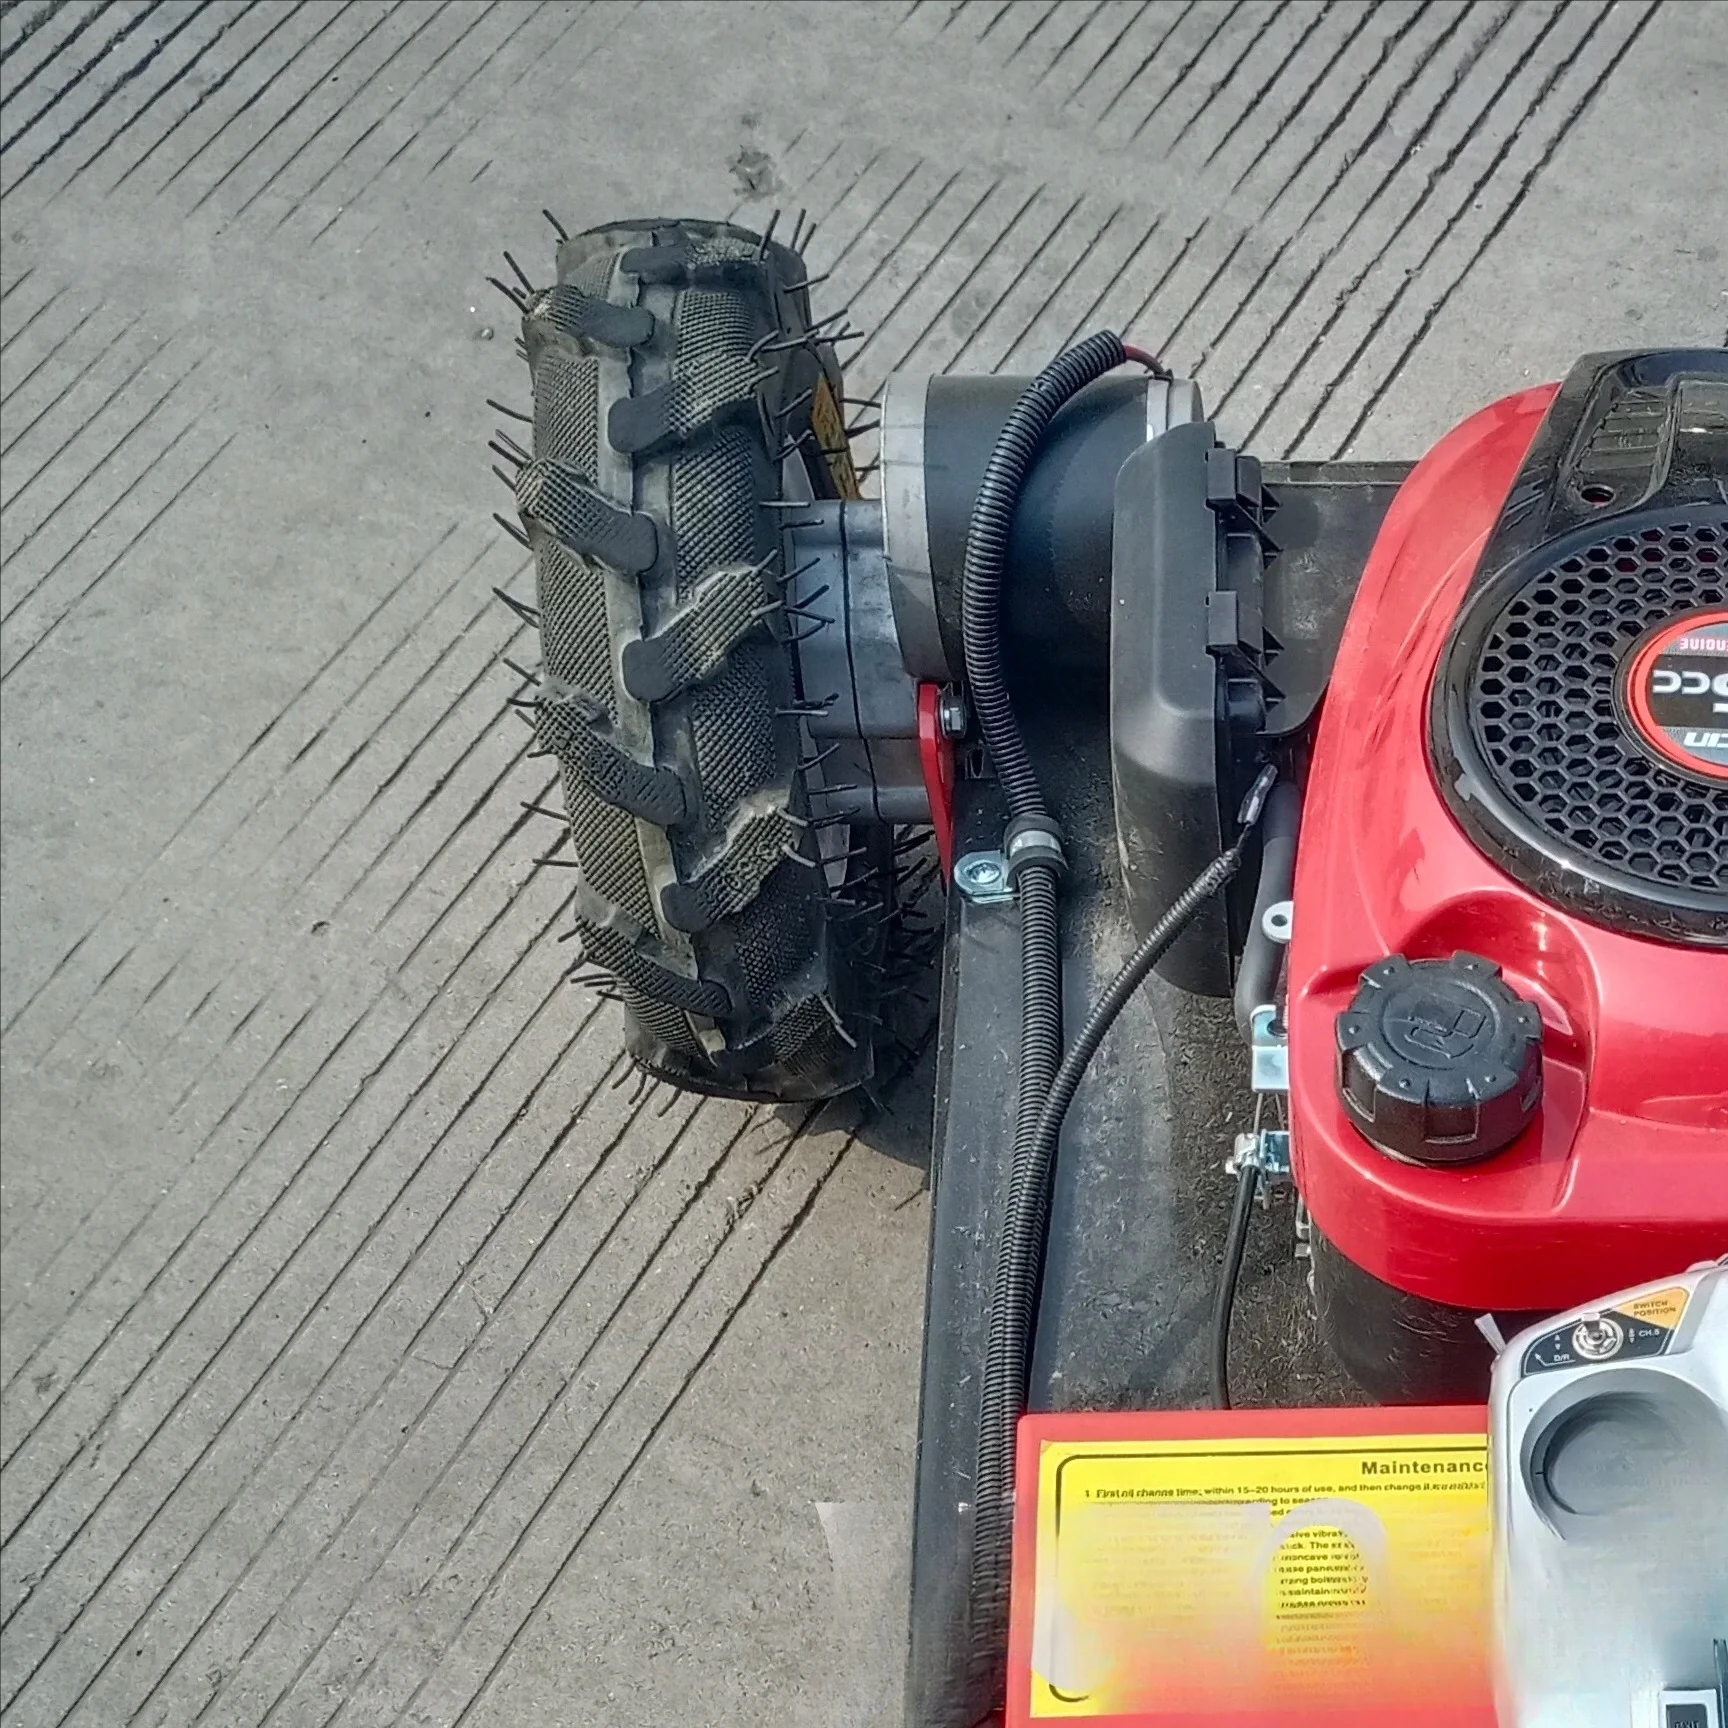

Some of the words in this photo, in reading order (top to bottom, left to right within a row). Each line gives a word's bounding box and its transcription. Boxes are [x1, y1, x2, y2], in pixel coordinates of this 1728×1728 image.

[1361, 1460, 1487, 1475] Maintenanc
[1270, 1485, 1300, 1494] hours
[1301, 1485, 1312, 1493] of
[1338, 1483, 1358, 1492] and
[1359, 1483, 1382, 1491] then
[1384, 1483, 1422, 1492] change
